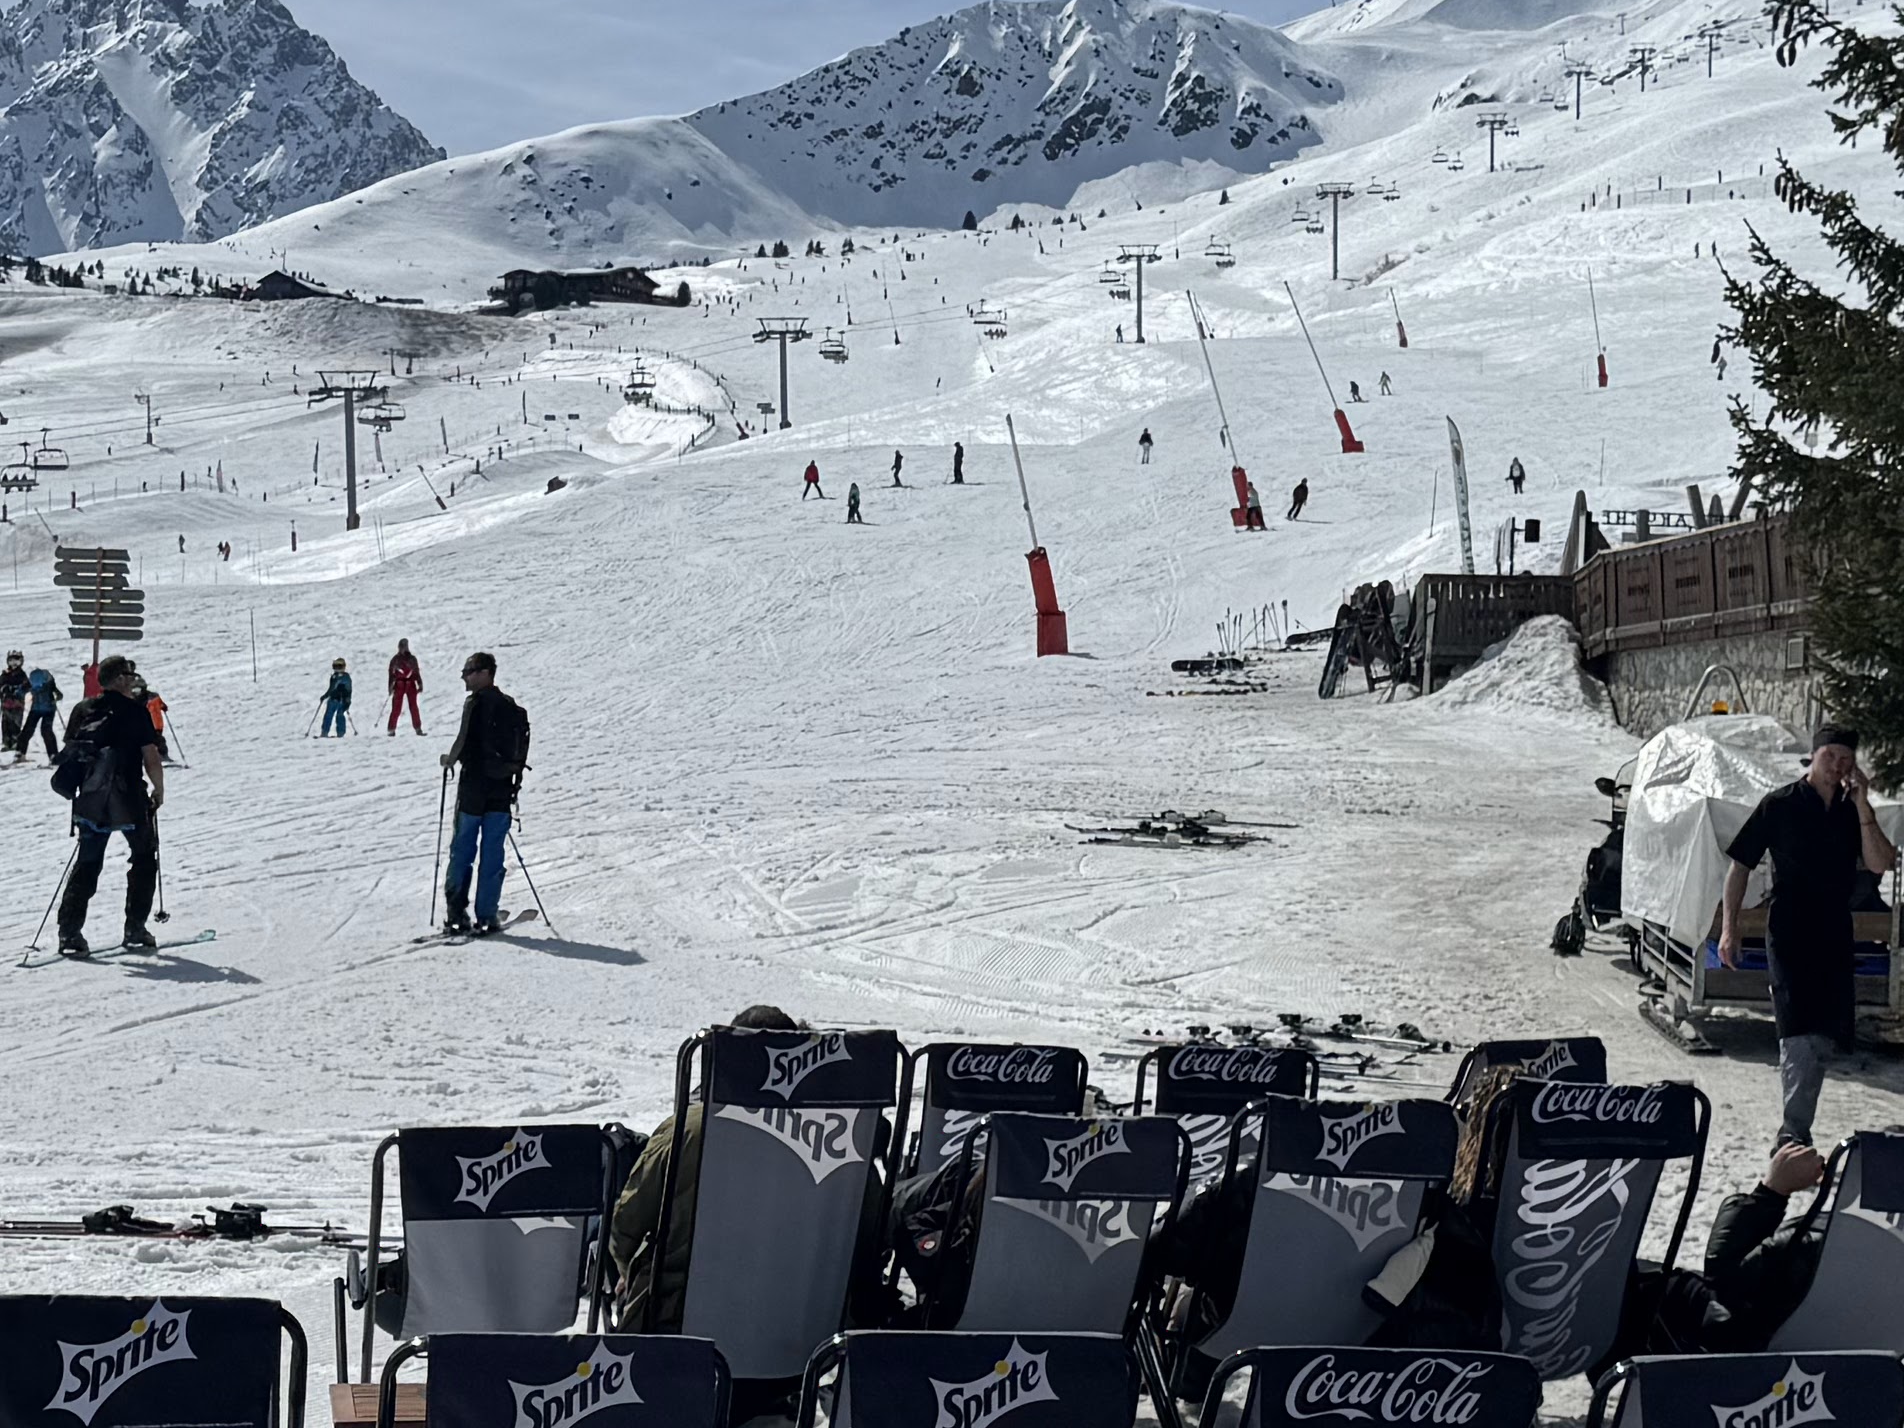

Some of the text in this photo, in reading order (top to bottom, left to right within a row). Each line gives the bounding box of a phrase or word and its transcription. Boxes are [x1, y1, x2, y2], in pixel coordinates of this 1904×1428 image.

[771, 1032, 841, 1087] Sprite
[947, 1045, 1059, 1083] Coca-Cola
[1168, 1045, 1284, 1084] Coca-Cola
[1326, 1103, 1394, 1157] Sprite
[1531, 1081, 1670, 1124] Coca-Cola
[465, 1139, 538, 1197] Sprite
[1052, 1122, 1119, 1179] Sprite
[63, 1317, 179, 1403] Sprite
[1285, 1354, 1494, 1424] Coca-Cola
